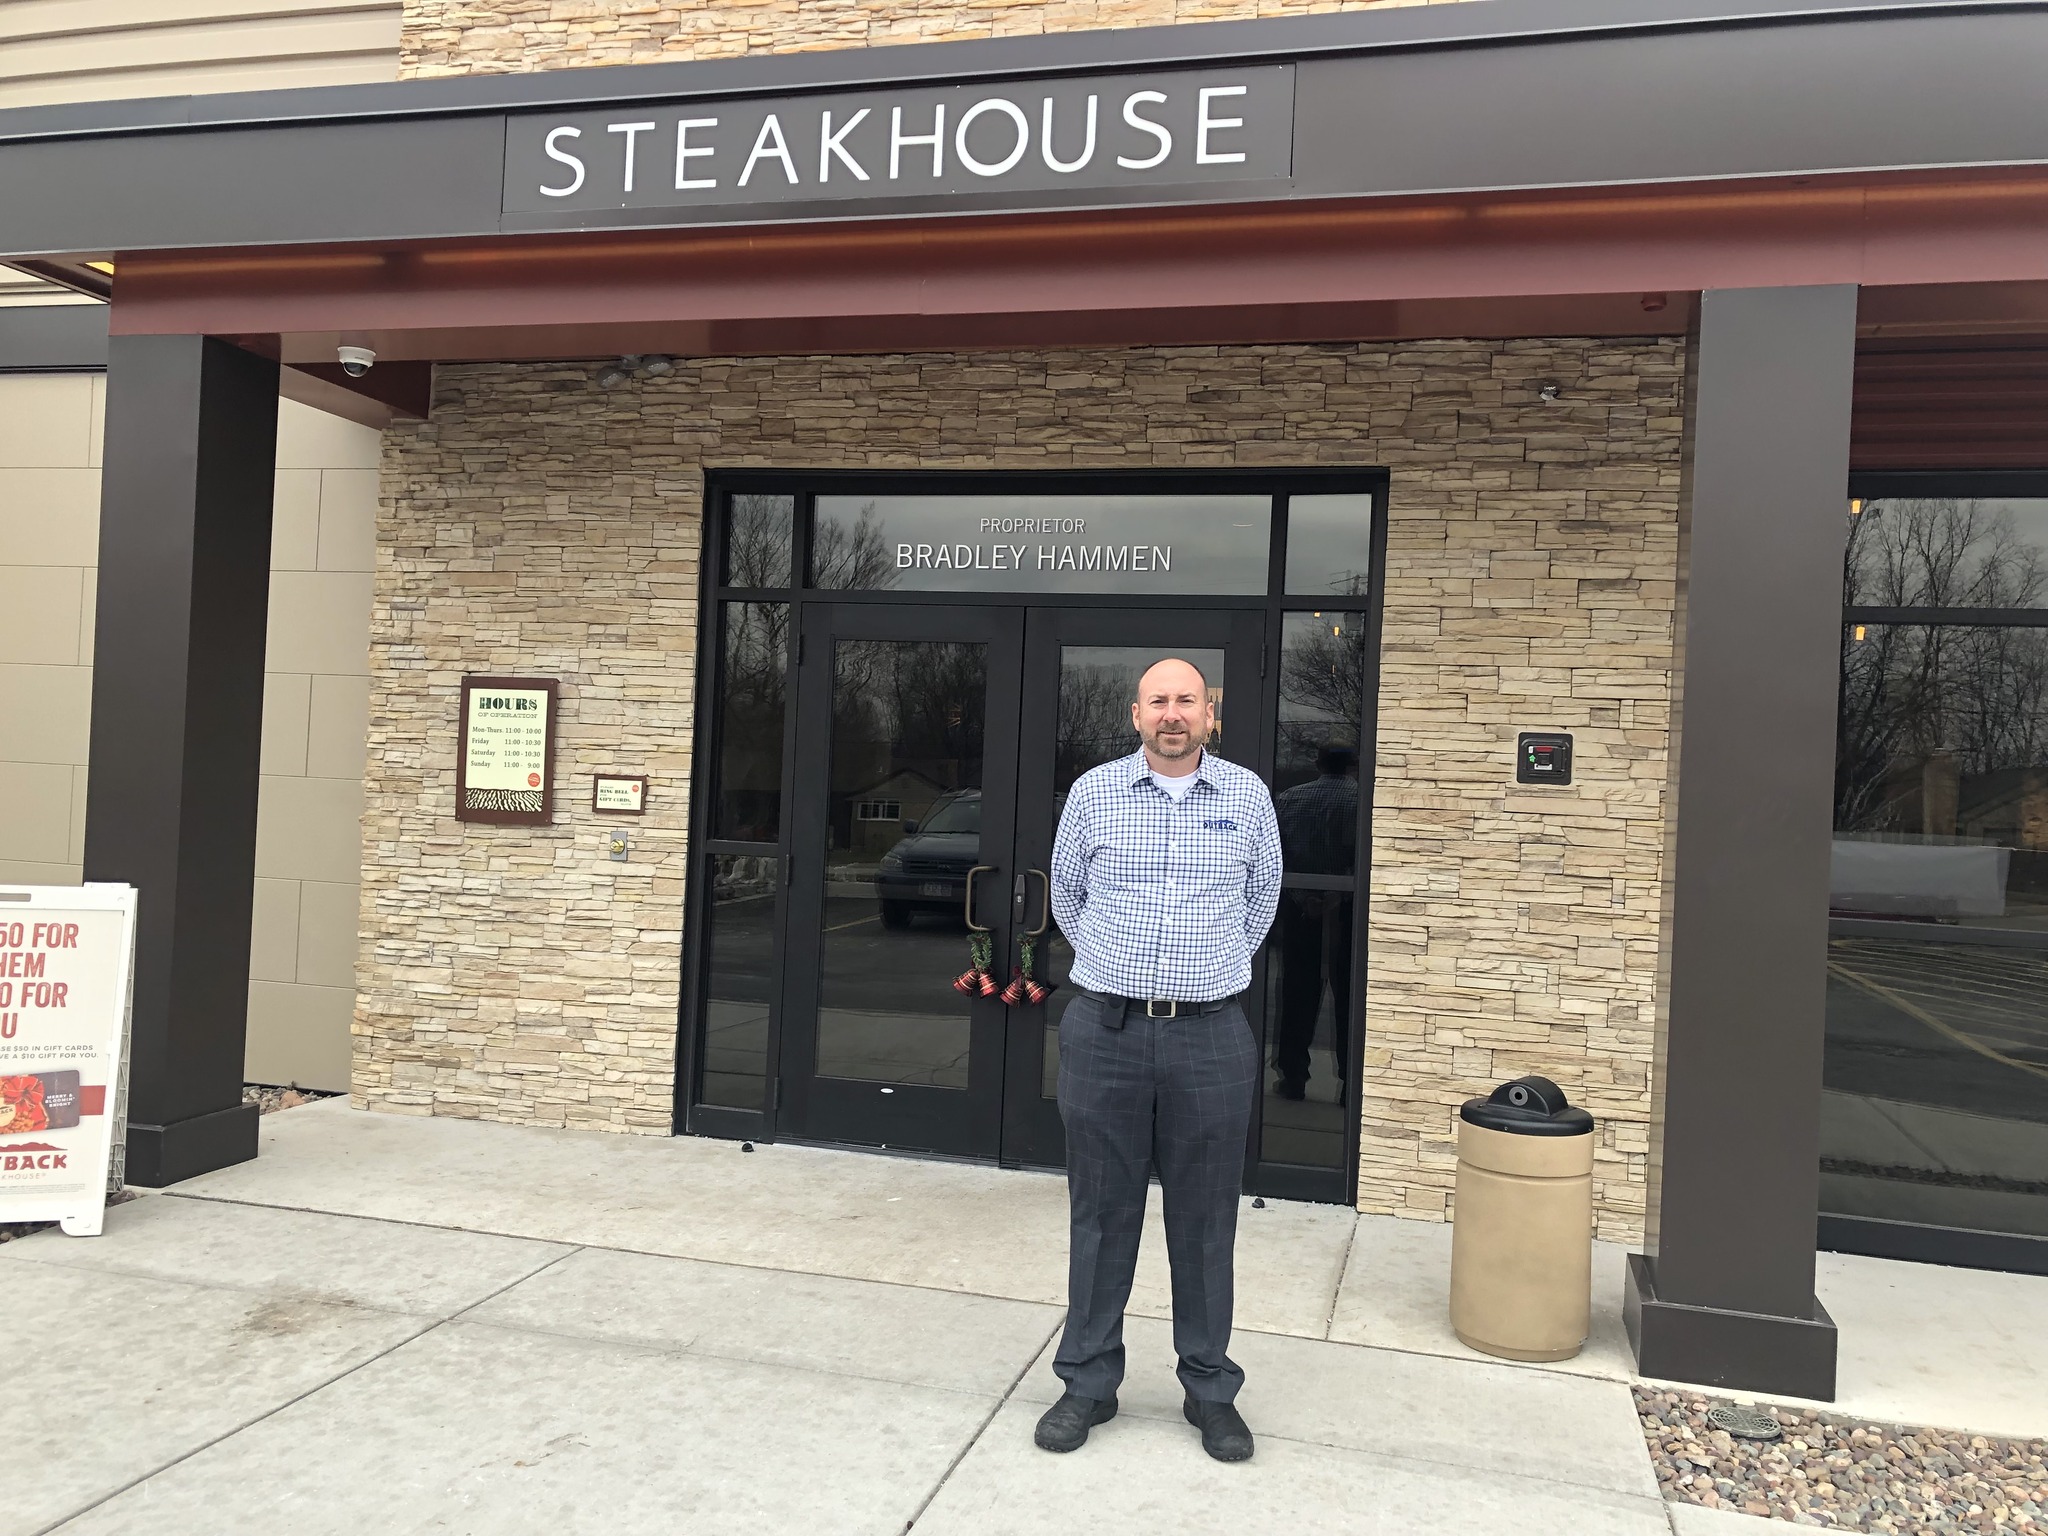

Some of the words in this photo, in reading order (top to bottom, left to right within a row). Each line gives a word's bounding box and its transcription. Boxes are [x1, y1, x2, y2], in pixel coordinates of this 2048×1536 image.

[539, 85, 1248, 197] STEAKHOUSE
[980, 518, 1087, 534] PROPRIETOR
[896, 543, 1028, 571] BRADLEY
[1037, 545, 1172, 572] HAMMEN
[479, 697, 538, 711] HOURS
[471, 749, 496, 757] Saturday
[32, 922, 79, 948] FOR
[20, 982, 68, 1008] FOR
[0, 1154, 68, 1170] BACK
